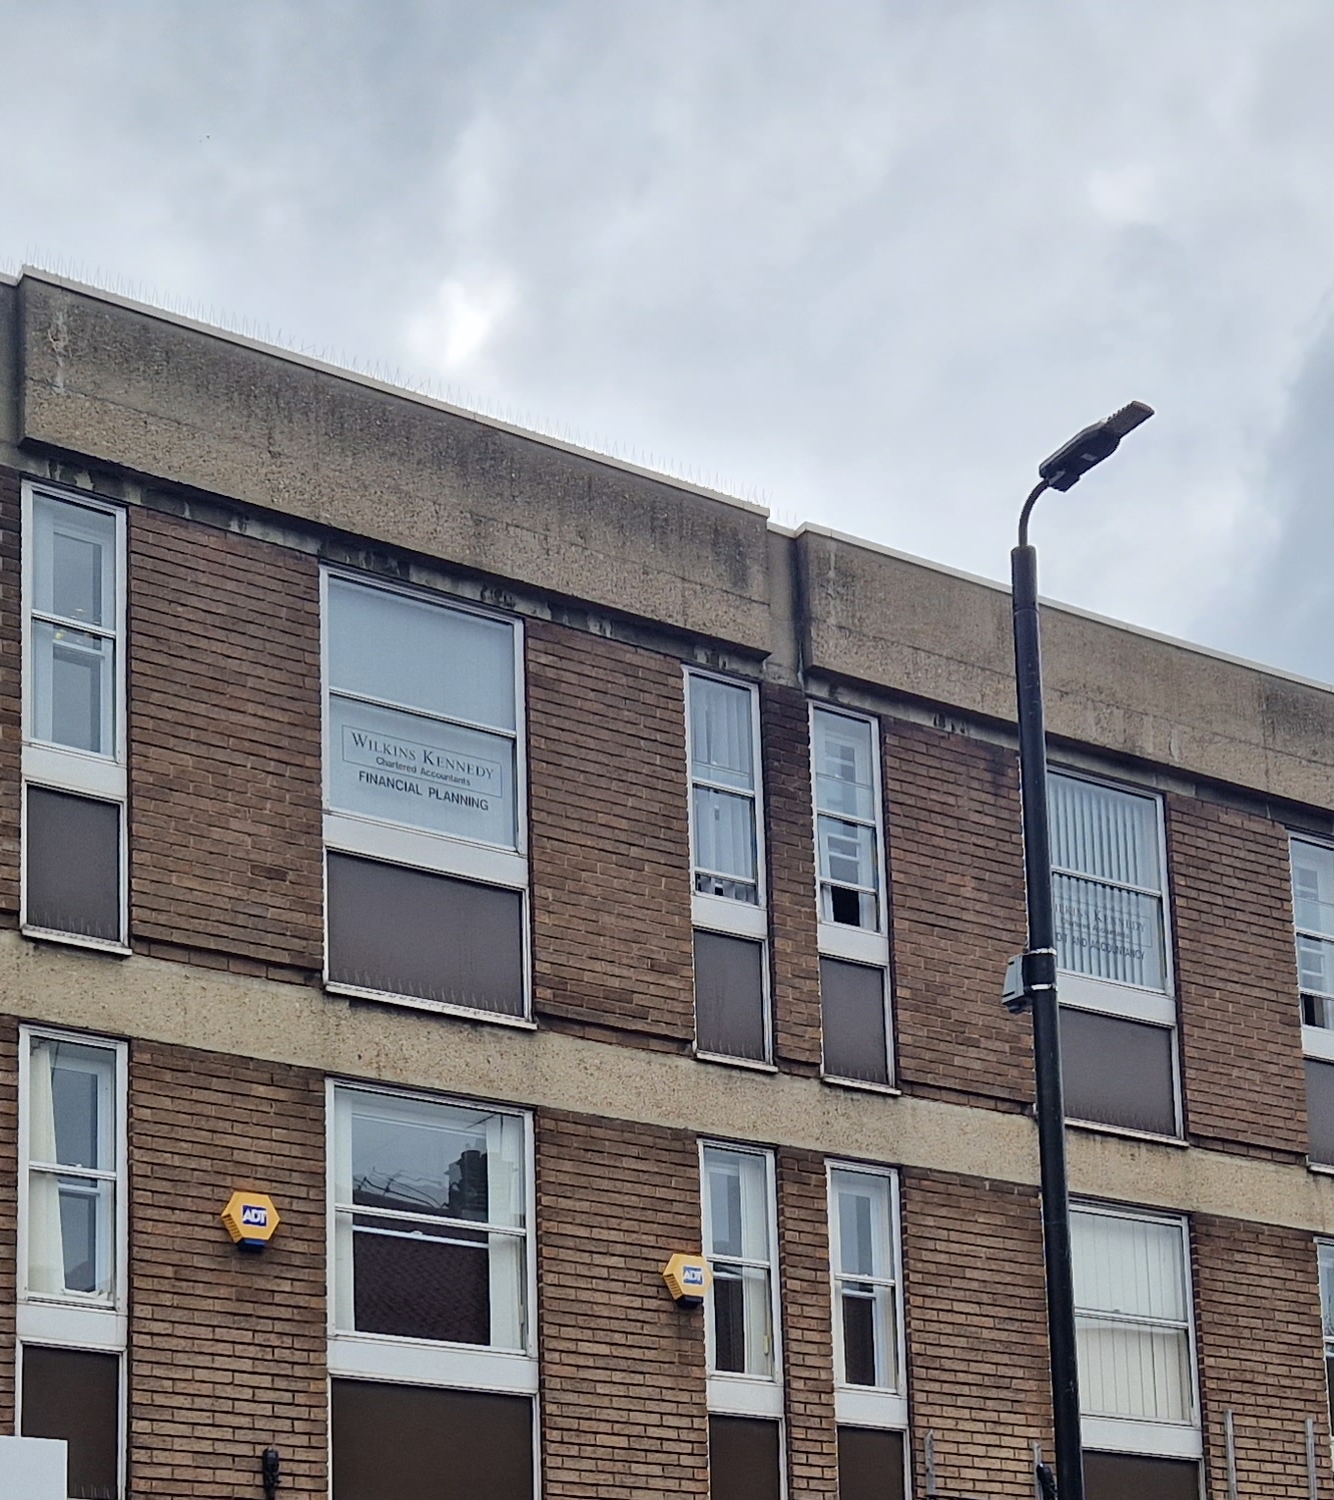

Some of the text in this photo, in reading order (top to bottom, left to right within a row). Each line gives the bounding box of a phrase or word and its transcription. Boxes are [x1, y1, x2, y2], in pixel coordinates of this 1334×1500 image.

[351, 731, 495, 780] WILKINS KENNEDY
[375, 755, 471, 786] Chartered Accountants
[358, 769, 490, 812] FINANCIAL PLANNING
[242, 1207, 267, 1225] ADT
[682, 1268, 704, 1284] ADT
